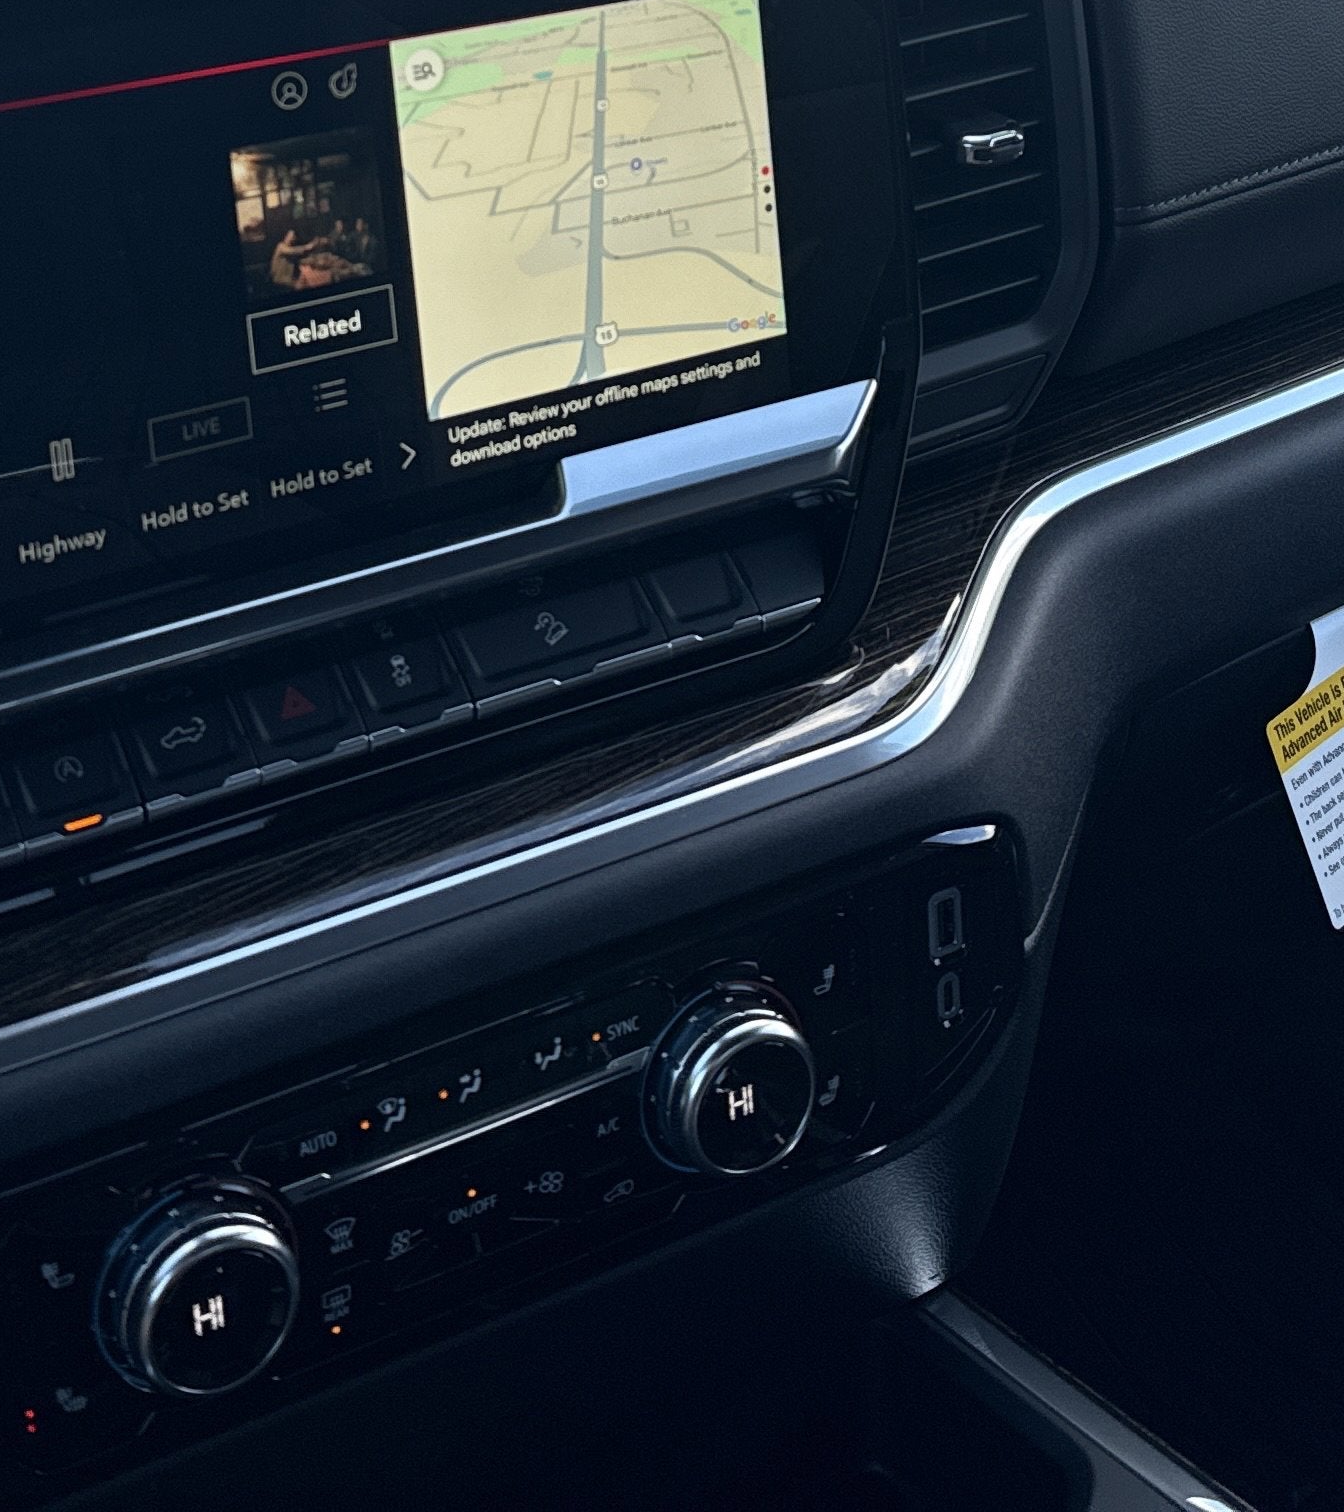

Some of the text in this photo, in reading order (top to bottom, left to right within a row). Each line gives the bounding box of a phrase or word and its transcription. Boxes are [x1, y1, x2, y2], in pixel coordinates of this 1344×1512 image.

[284, 309, 362, 347] Related
[447, 351, 761, 444] Update: Review your offline maps settings and
[181, 416, 221, 441] LIVE
[449, 421, 577, 467] download options
[270, 457, 373, 498] Hold to Set
[141, 489, 250, 532] Hold to Set
[18, 528, 107, 564] Highway
[1273, 717, 1296, 741] This
[1293, 691, 1331, 725] Vehicle
[1329, 683, 1341, 700] is
[1281, 715, 1328, 762] Advanced
[1327, 706, 1342, 727] Air
[1290, 772, 1308, 790] Even
[1307, 760, 1323, 777] with
[1303, 781, 1330, 806] Children
[1308, 809, 1322, 823] The
[1320, 797, 1337, 814] back
[1333, 812, 1344, 829] put
[1322, 836, 1343, 858] Always
[1327, 861, 1340, 875] See
[1332, 907, 1342, 918] To
[606, 1015, 640, 1042] SYNC
[727, 1084, 755, 1121] HI
[596, 1117, 620, 1138] A/C
[299, 1130, 337, 1157] AUTO
[448, 1194, 499, 1224] ON/OFF
[192, 1294, 225, 1337] HI
